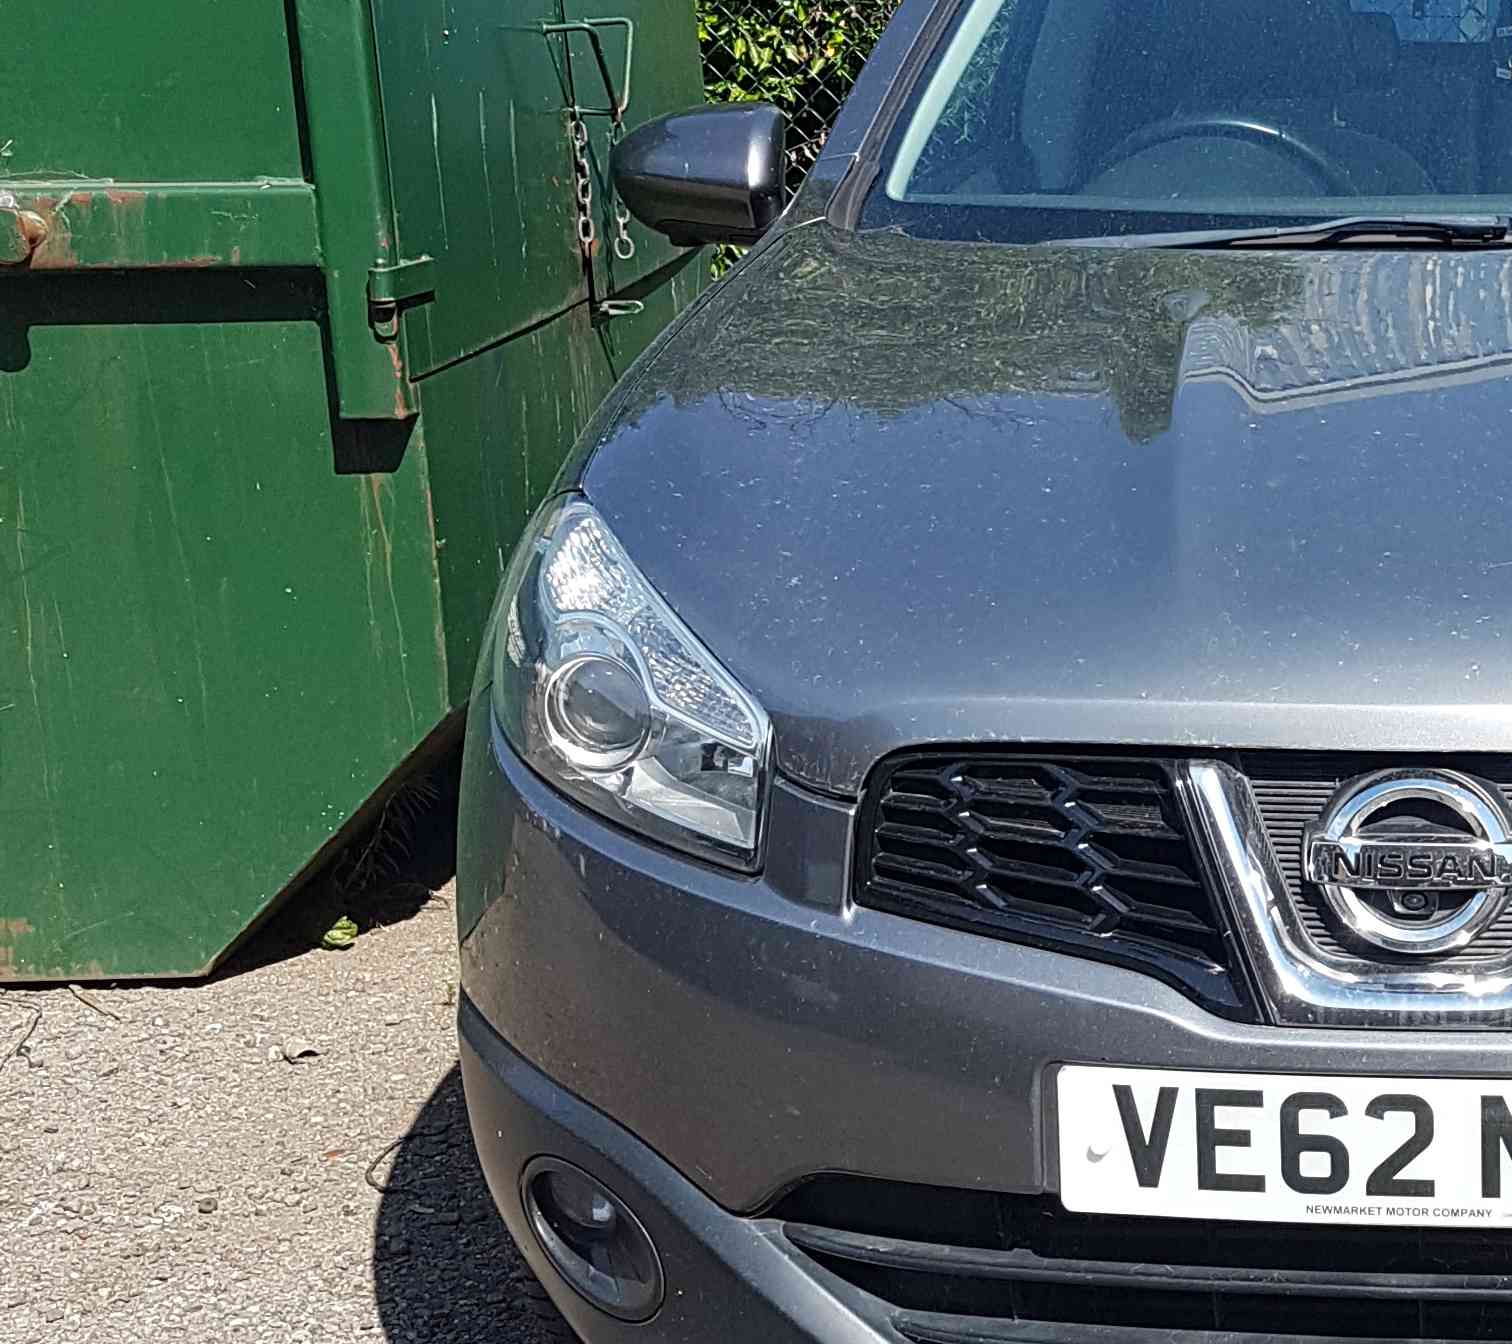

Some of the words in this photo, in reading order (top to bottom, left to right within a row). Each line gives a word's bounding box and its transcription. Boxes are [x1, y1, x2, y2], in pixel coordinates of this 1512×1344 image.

[1332, 848, 1497, 882] NISSAN
[1112, 1083, 1436, 1198] VE62
[1306, 1204, 1382, 1216] NEWMARKET
[1386, 1206, 1429, 1217] MOTOR
[1432, 1207, 1492, 1218] COMPANY
